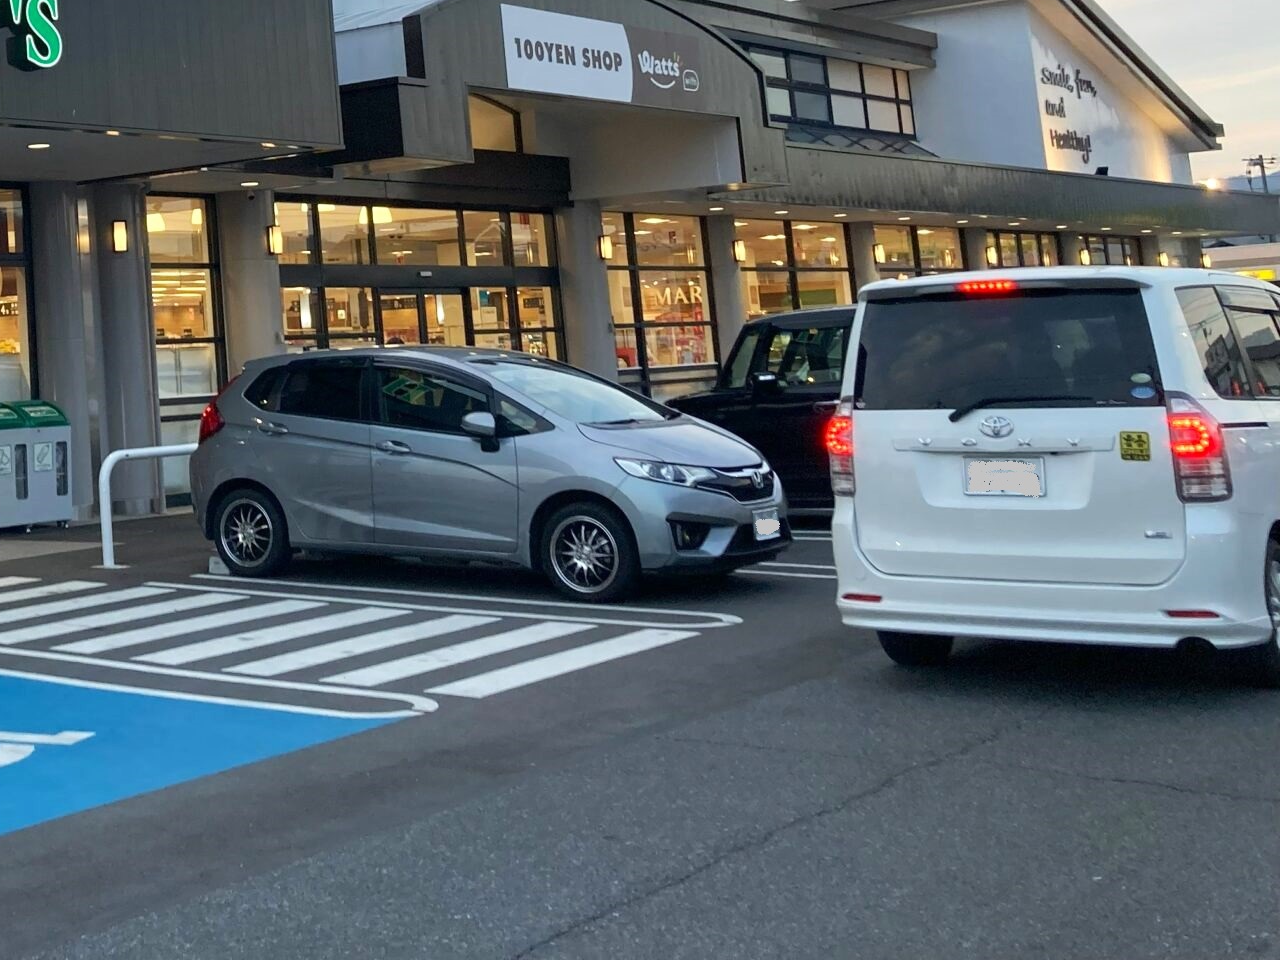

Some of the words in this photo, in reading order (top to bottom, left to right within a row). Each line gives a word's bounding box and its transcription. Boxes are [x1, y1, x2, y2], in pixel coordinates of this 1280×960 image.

[514, 37, 576, 66] 100YEN
[582, 48, 623, 72] SHOP
[637, 50, 680, 77] Watts
[1049, 128, 1092, 164] Healthy!
